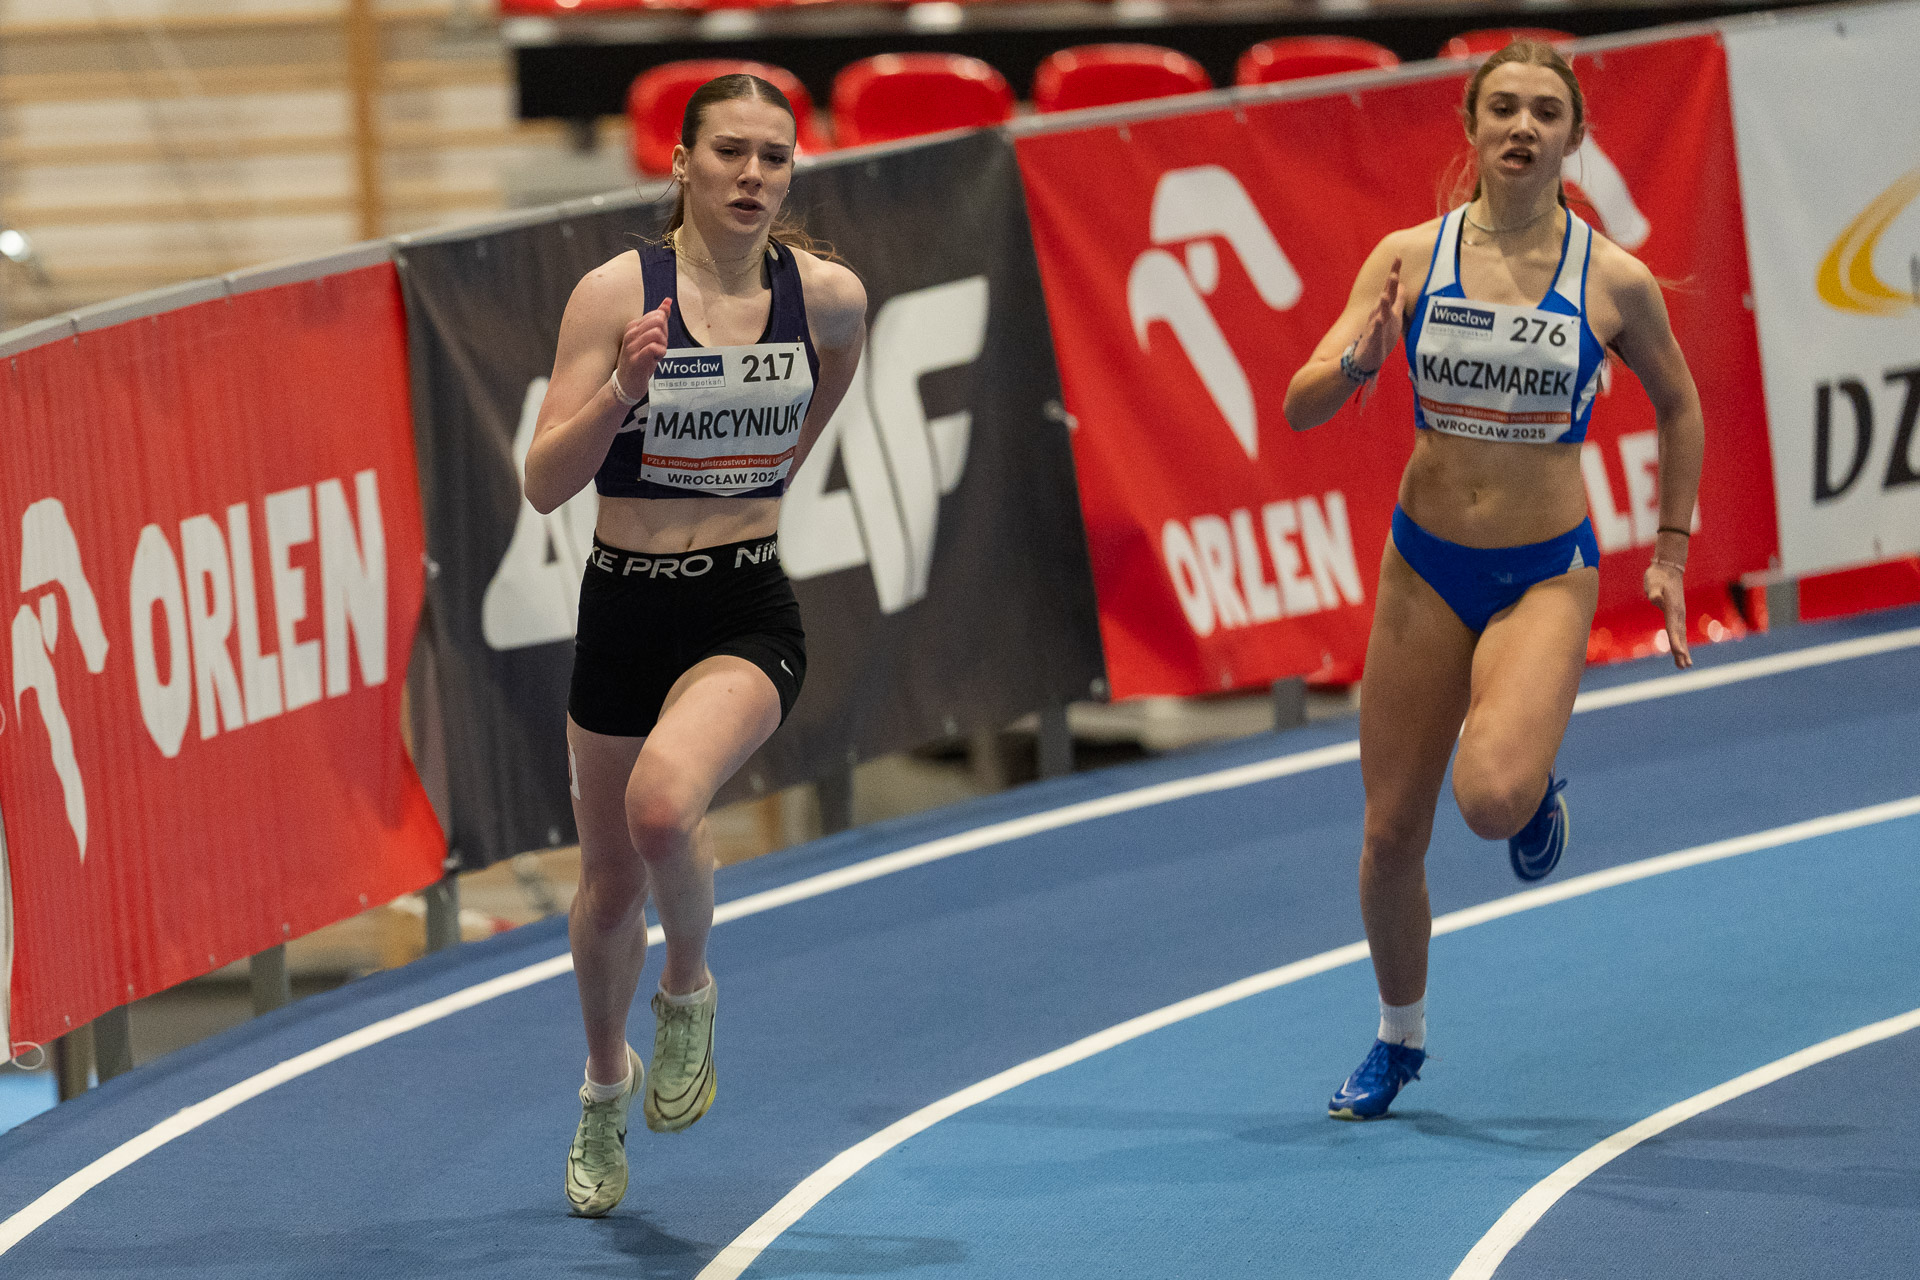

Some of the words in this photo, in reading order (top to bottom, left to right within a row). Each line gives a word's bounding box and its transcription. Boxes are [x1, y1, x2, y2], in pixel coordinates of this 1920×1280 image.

[1510, 316, 1567, 347] 276
[741, 352, 794, 383] 217
[1422, 354, 1572, 397] KACZMAREK
[653, 402, 803, 441] MARCYNIUK
[1512, 428, 1546, 440] 2025
[647, 457, 667, 466] PZLA
[668, 472, 748, 486] WROCŁAW
[622, 554, 714, 579] PRO
[1161, 489, 1365, 639] ORLEN
[130, 467, 388, 760] ORLEN
